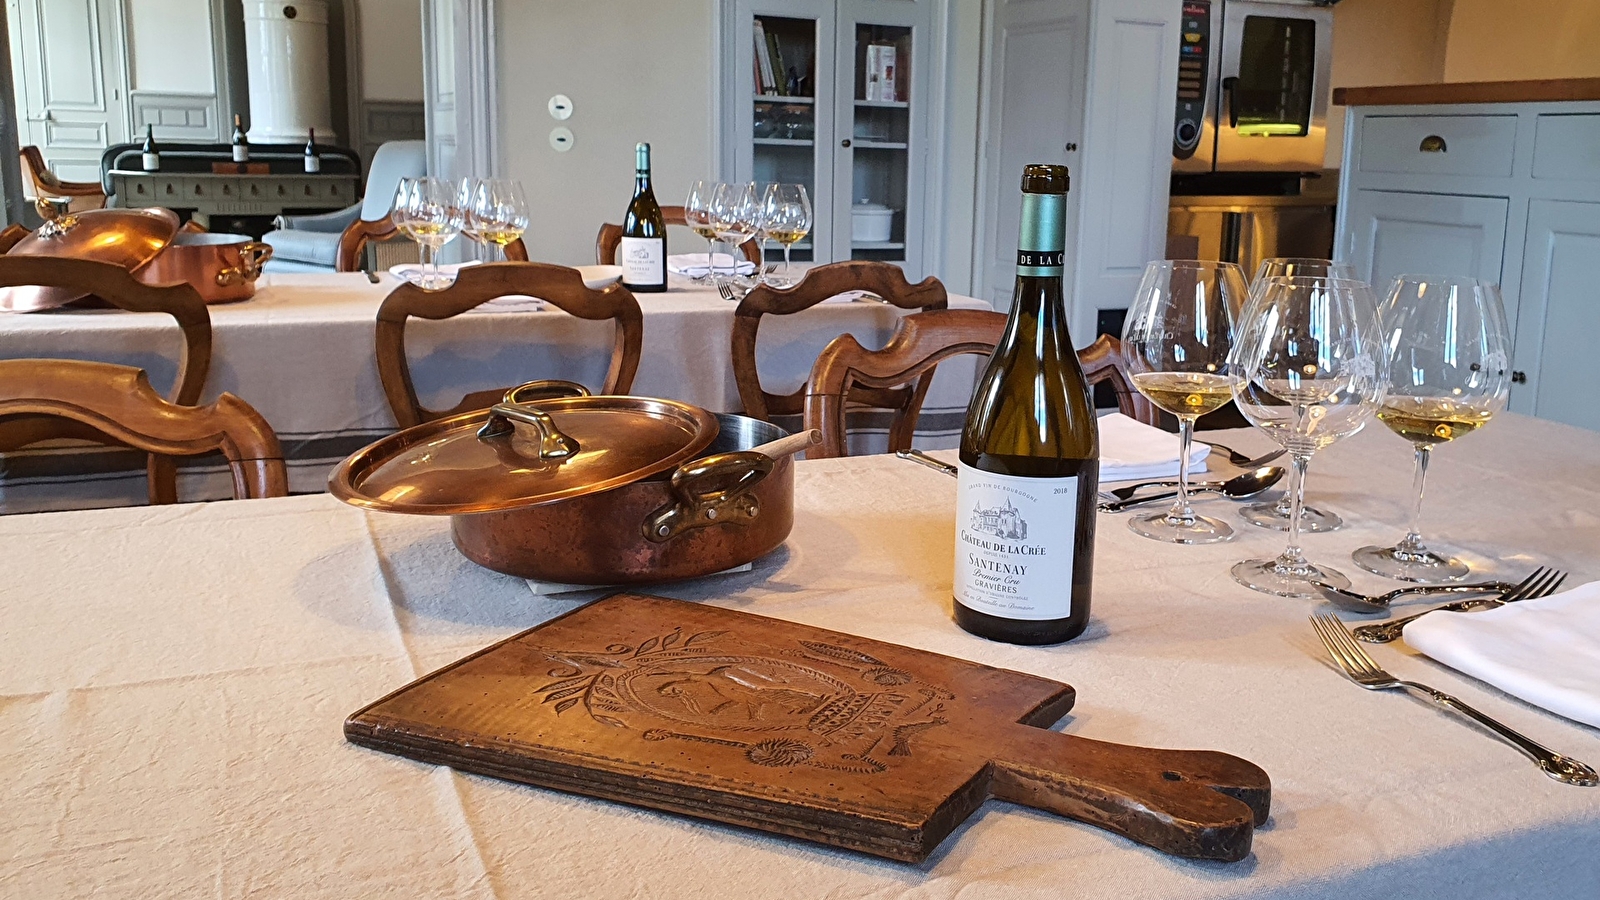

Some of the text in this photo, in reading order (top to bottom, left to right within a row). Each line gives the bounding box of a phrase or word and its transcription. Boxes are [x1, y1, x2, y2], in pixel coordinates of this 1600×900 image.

[1021, 254, 1032, 265] DE
[1040, 255, 1052, 265] LA
[1003, 486, 1038, 503] BOURGOGNE
[1053, 487, 1068, 495] 2018
[961, 529, 992, 550] CHÂTEAU
[993, 543, 1005, 553] DE
[1021, 544, 1047, 556] CRÉE
[969, 552, 1028, 575] SANTENAY
[972, 568, 1021, 585] Premier Cru
[974, 579, 1018, 594] GRAVIÈRES
